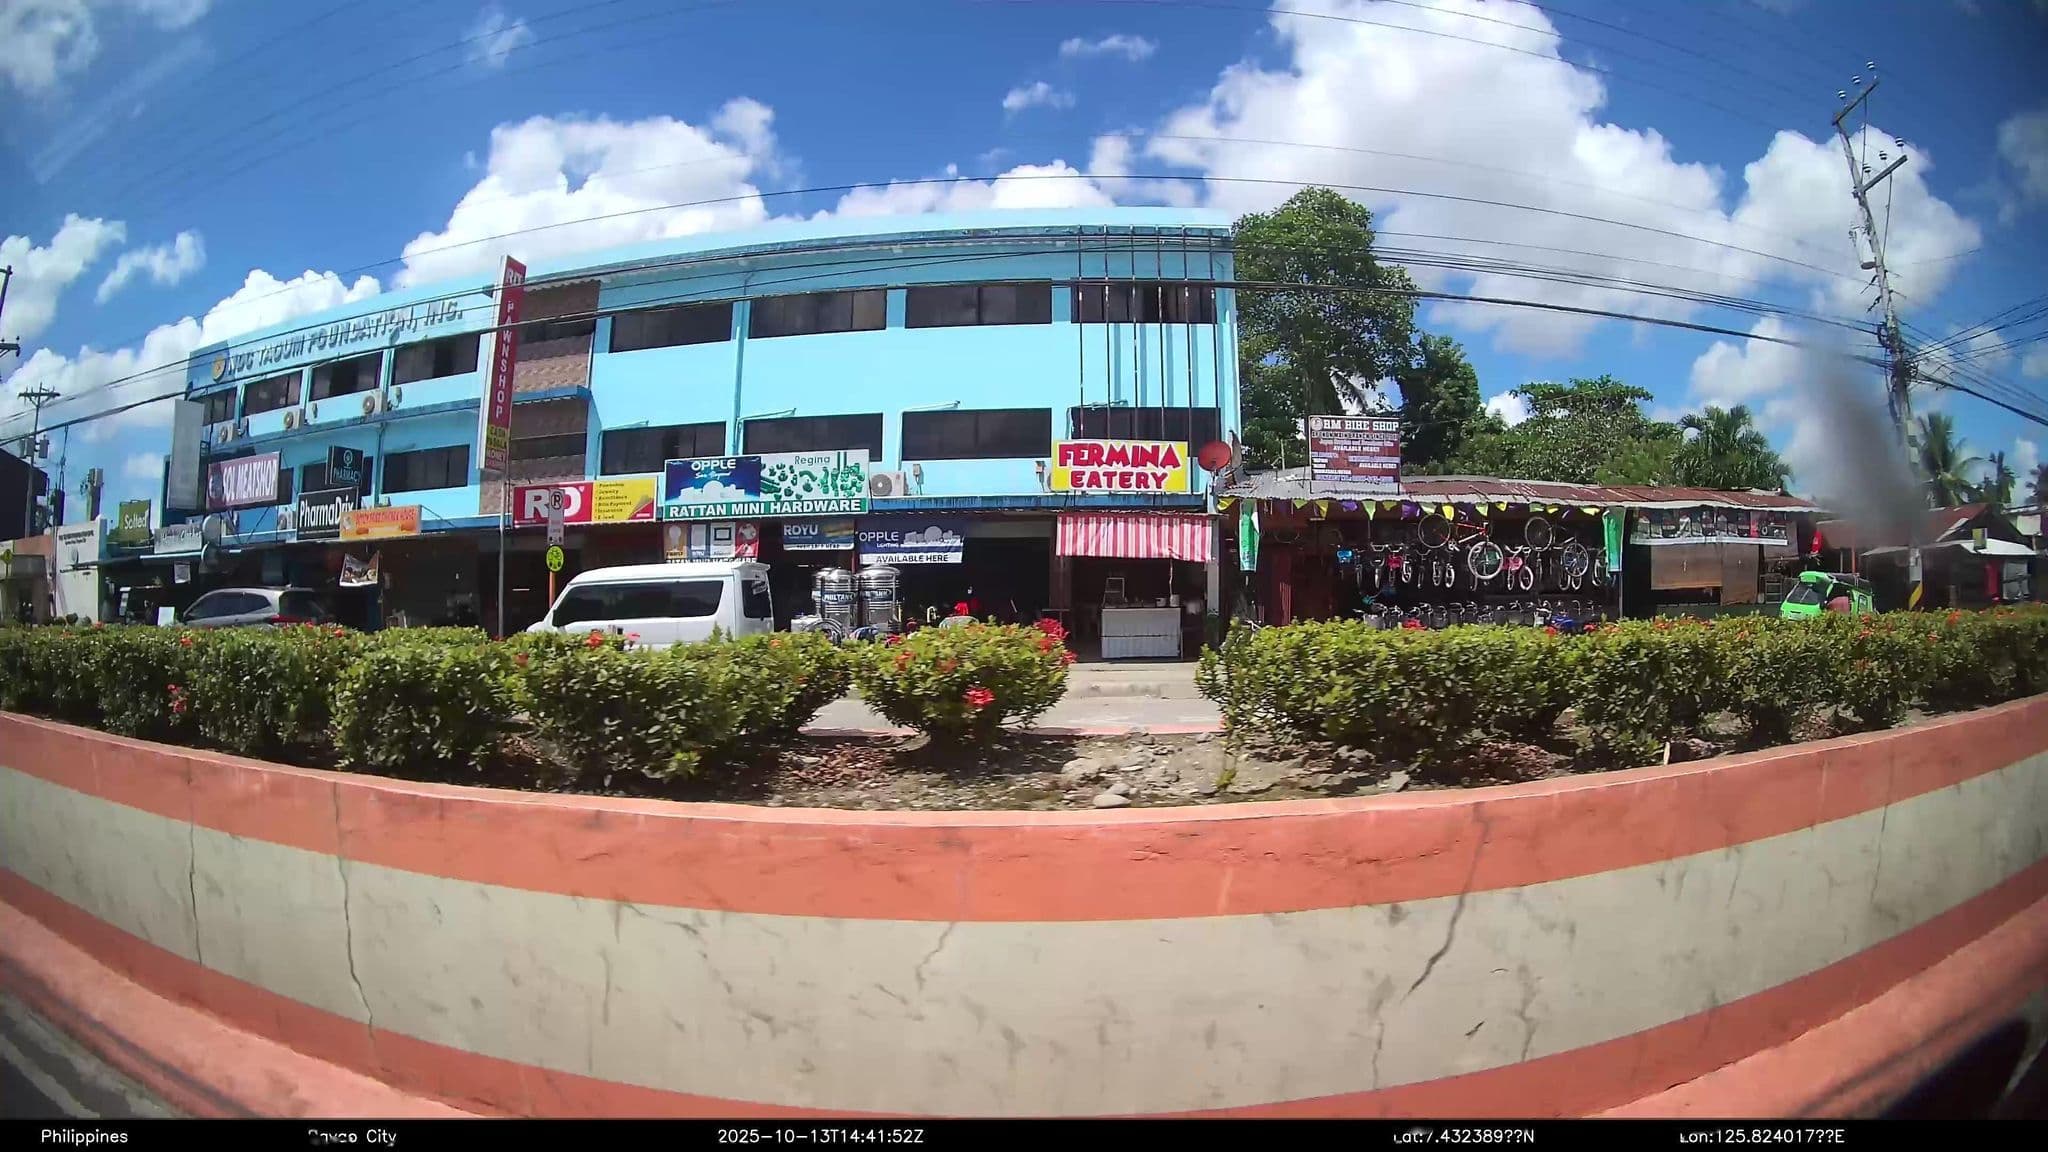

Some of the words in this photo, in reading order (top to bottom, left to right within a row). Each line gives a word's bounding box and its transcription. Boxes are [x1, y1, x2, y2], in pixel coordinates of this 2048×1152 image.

[495, 300, 515, 419] PAWNSHOP
[1345, 419, 1370, 430] BIKE
[1373, 420, 1399, 432] SHOP
[794, 455, 831, 466] Regina
[1058, 442, 1181, 469] FERMINA
[691, 458, 737, 471] OPPLE
[1070, 470, 1169, 490] EATERY
[670, 503, 727, 518] RATTAN
[731, 502, 765, 515] MINI
[770, 499, 861, 513] HARDWARE
[783, 524, 818, 536] ROYU
[859, 531, 900, 542] OPPLE
[875, 554, 924, 562] AVAILABLE
[926, 554, 949, 562] HERE
